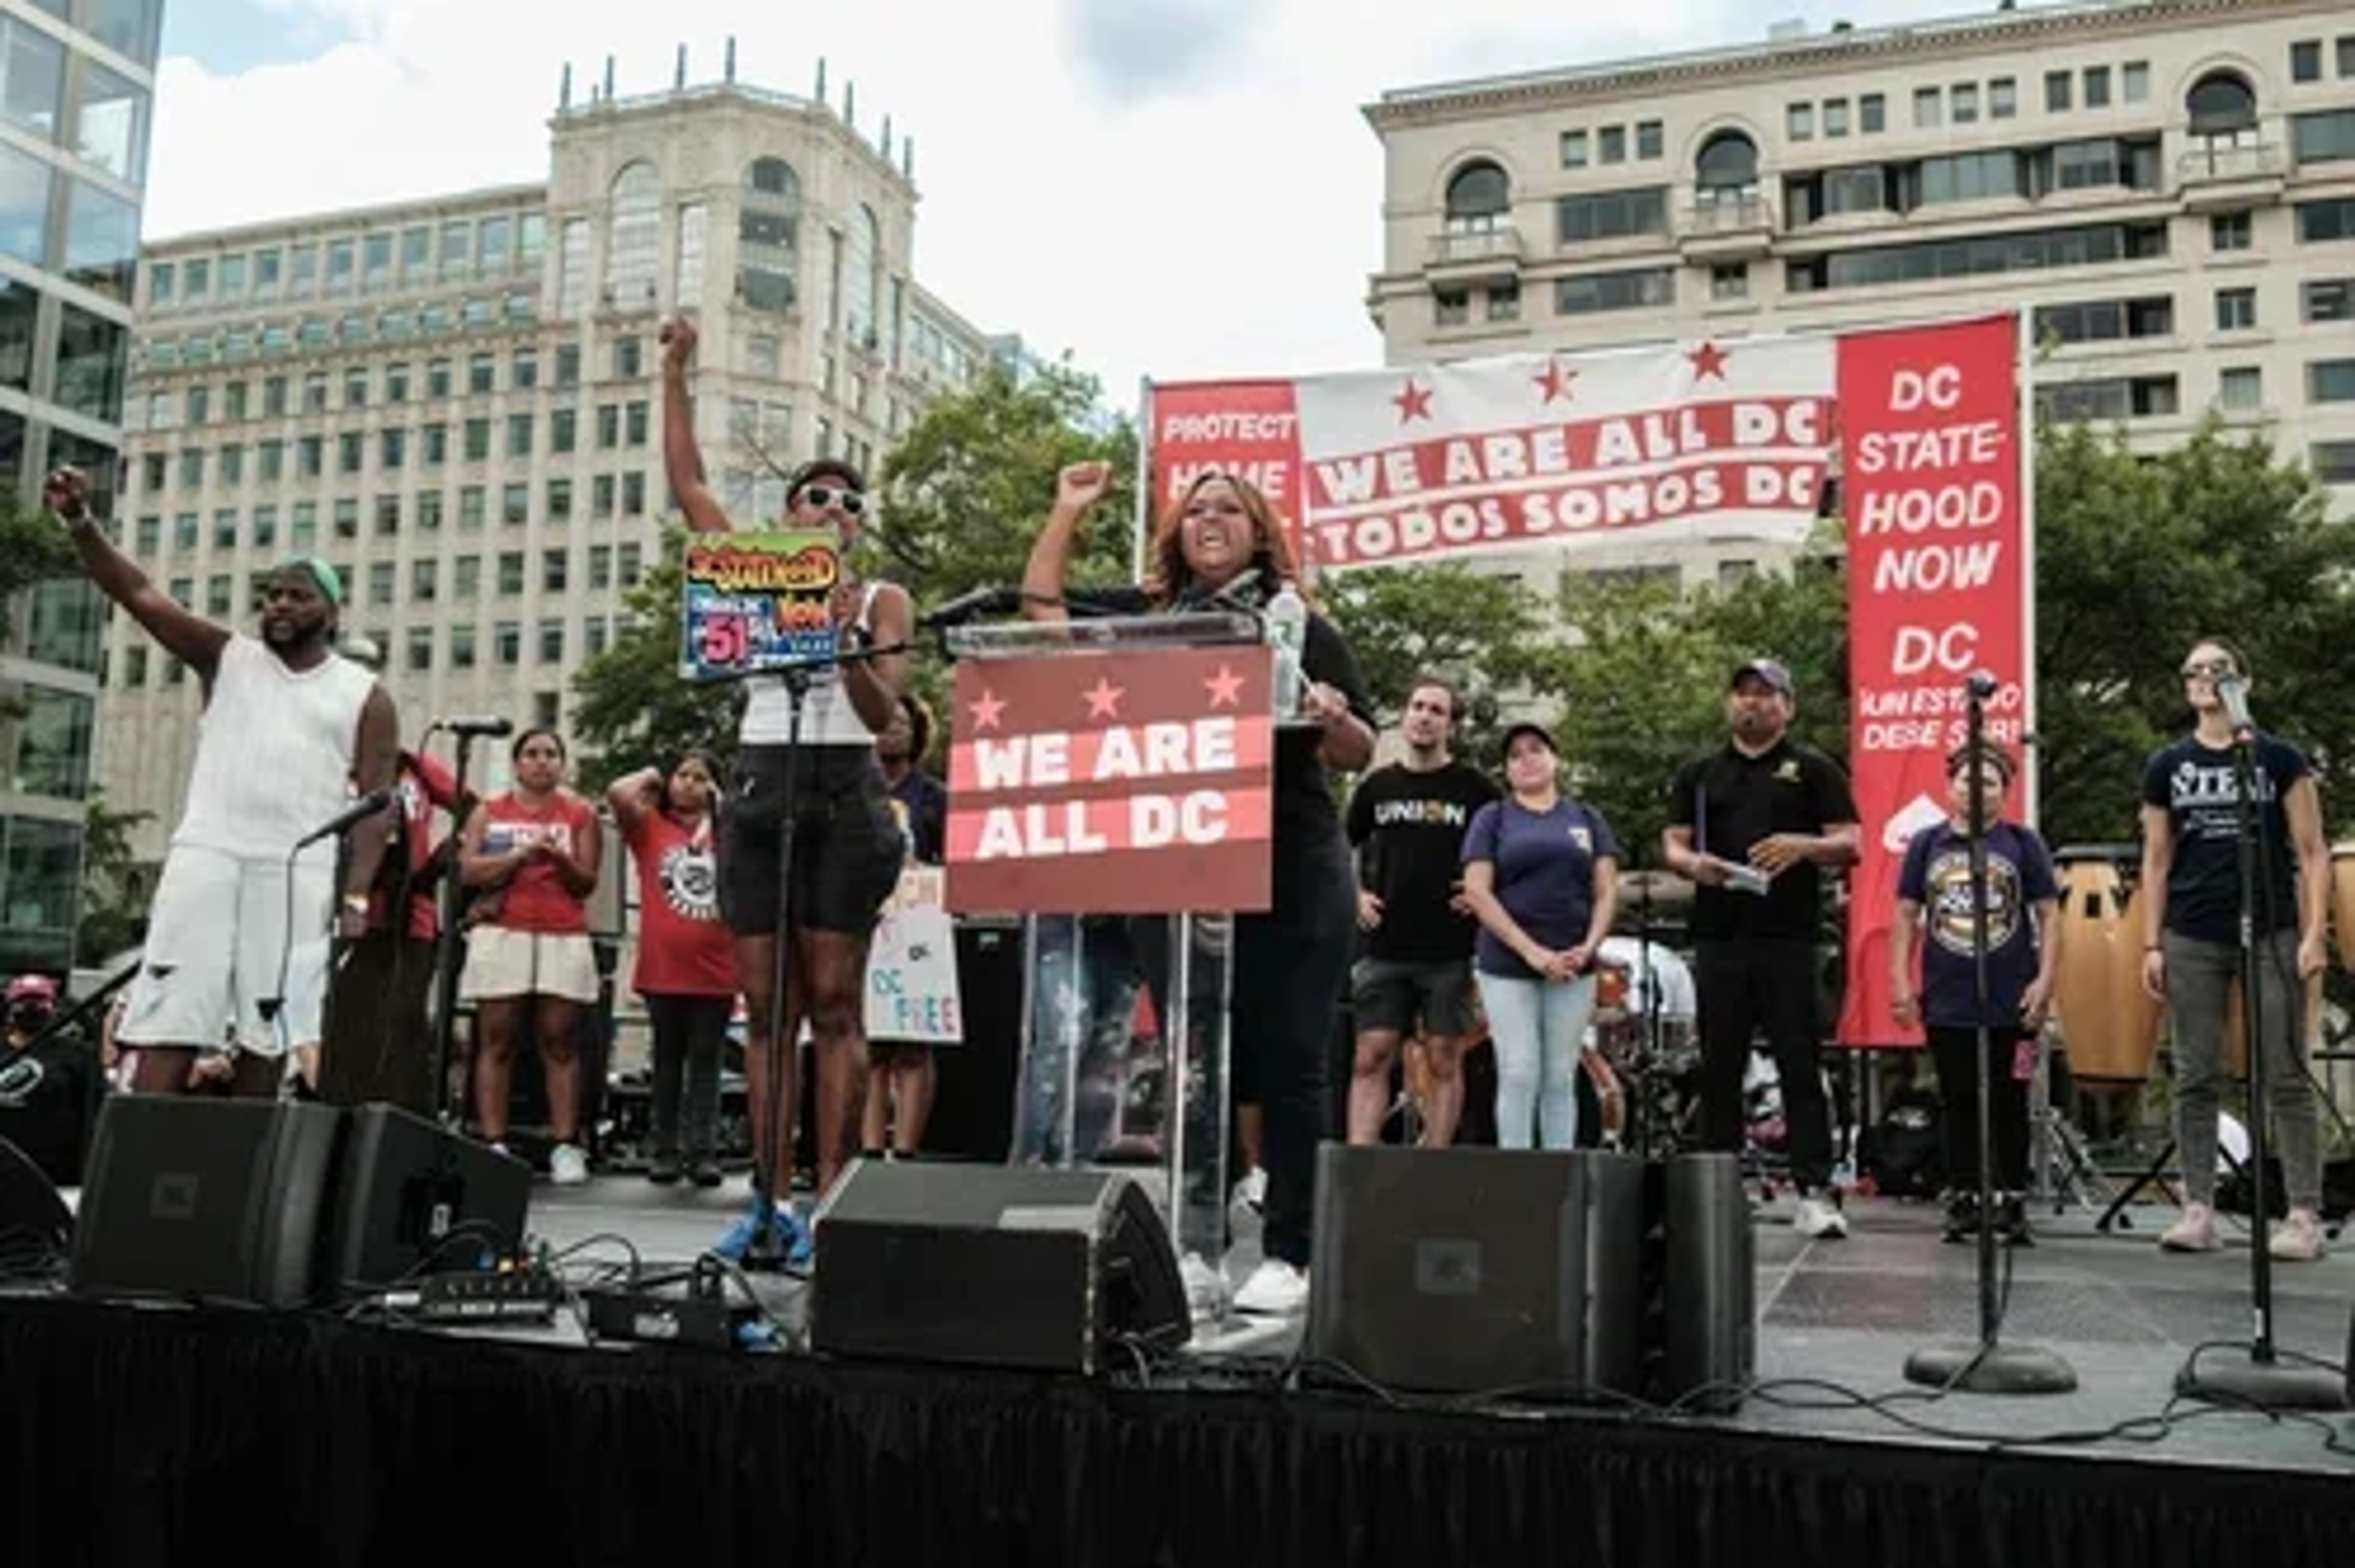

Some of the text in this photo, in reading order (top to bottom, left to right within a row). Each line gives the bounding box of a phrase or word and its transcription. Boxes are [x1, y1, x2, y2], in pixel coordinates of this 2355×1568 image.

[1890, 367, 1961, 411] DC
[1163, 413, 1295, 443] PROTECT
[1316, 400, 1818, 503] WE ARE ALL DC
[1320, 466, 1814, 560] TODOS SOMOS DC
[1859, 484, 2002, 535] HOOD
[1874, 540, 2002, 593] NOW
[703, 613, 747, 662] 51
[1893, 623, 1978, 675] DC
[1912, 683, 2021, 714] ESTO
[974, 716, 1235, 790] WE ARE
[975, 790, 1228, 860] ALL DC
[1374, 800, 1466, 825] UNION
